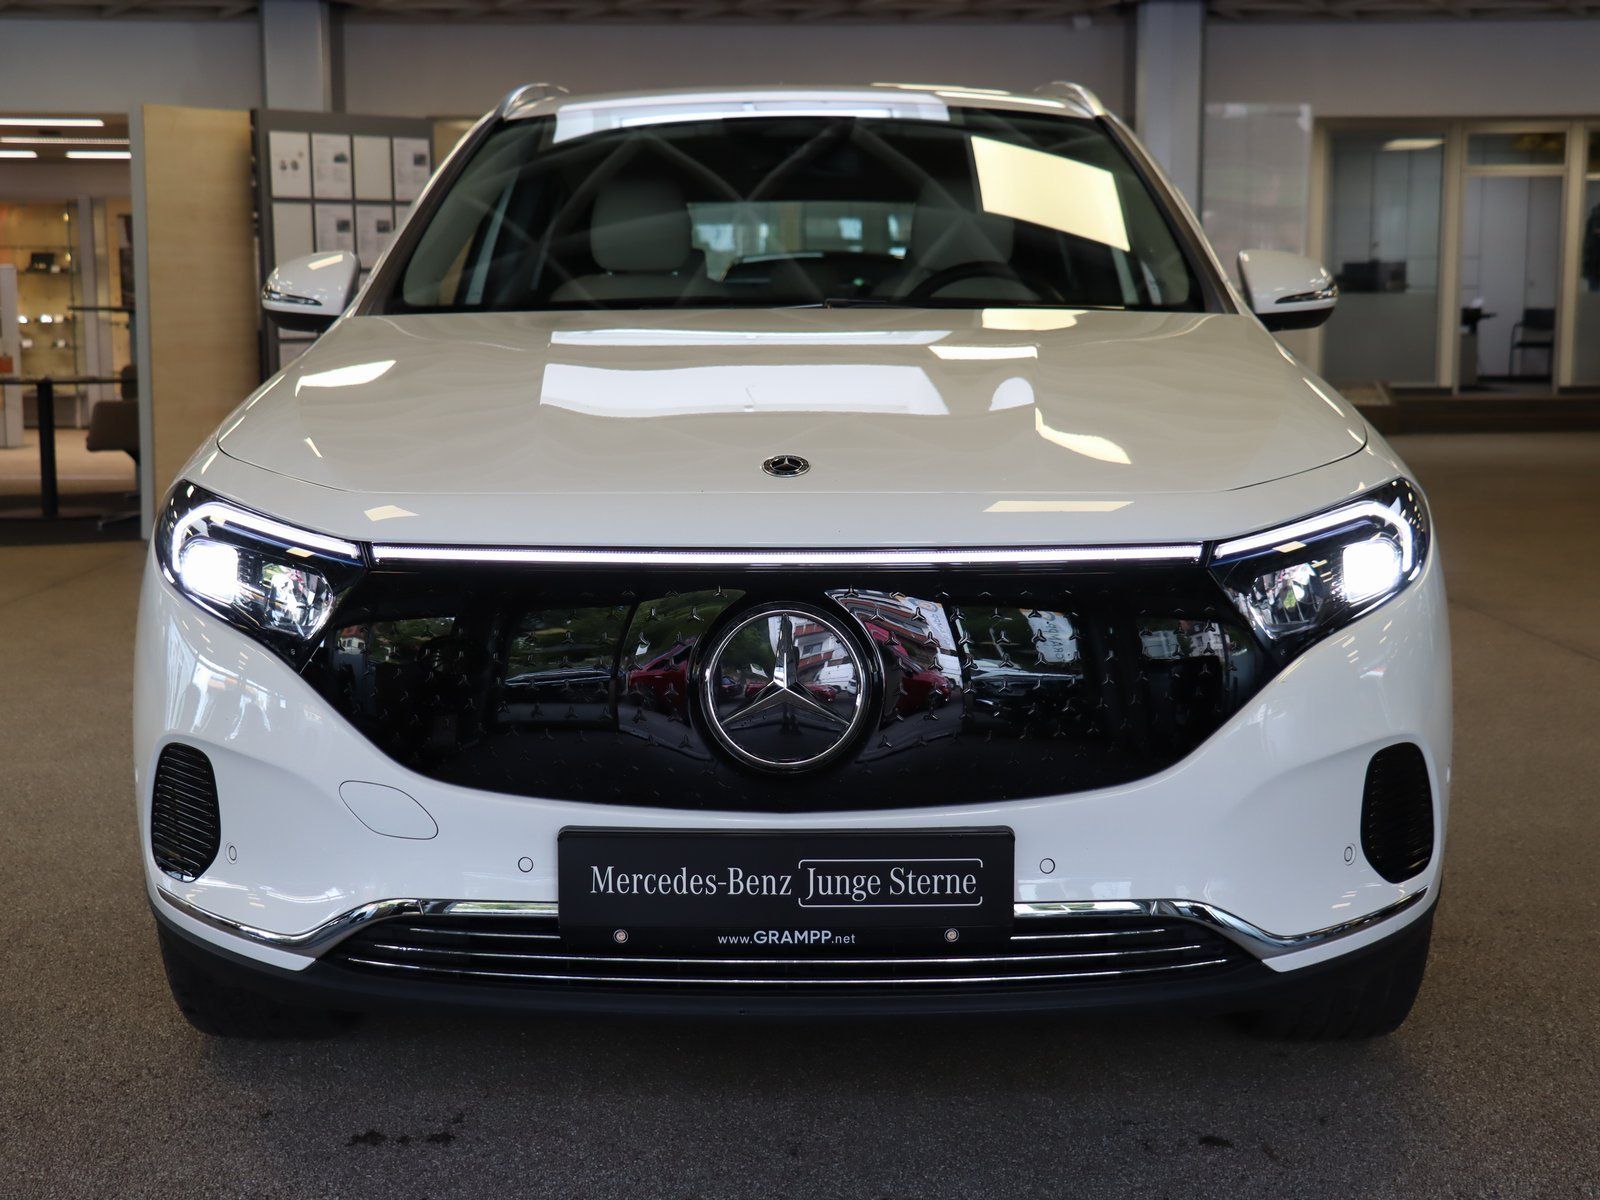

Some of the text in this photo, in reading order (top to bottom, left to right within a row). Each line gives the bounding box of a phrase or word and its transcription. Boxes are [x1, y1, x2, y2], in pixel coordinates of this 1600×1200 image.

[590, 865, 977, 902] Mercedes-Benz Junge Sterne
[717, 929, 856, 944] www.GRAMPP.net
